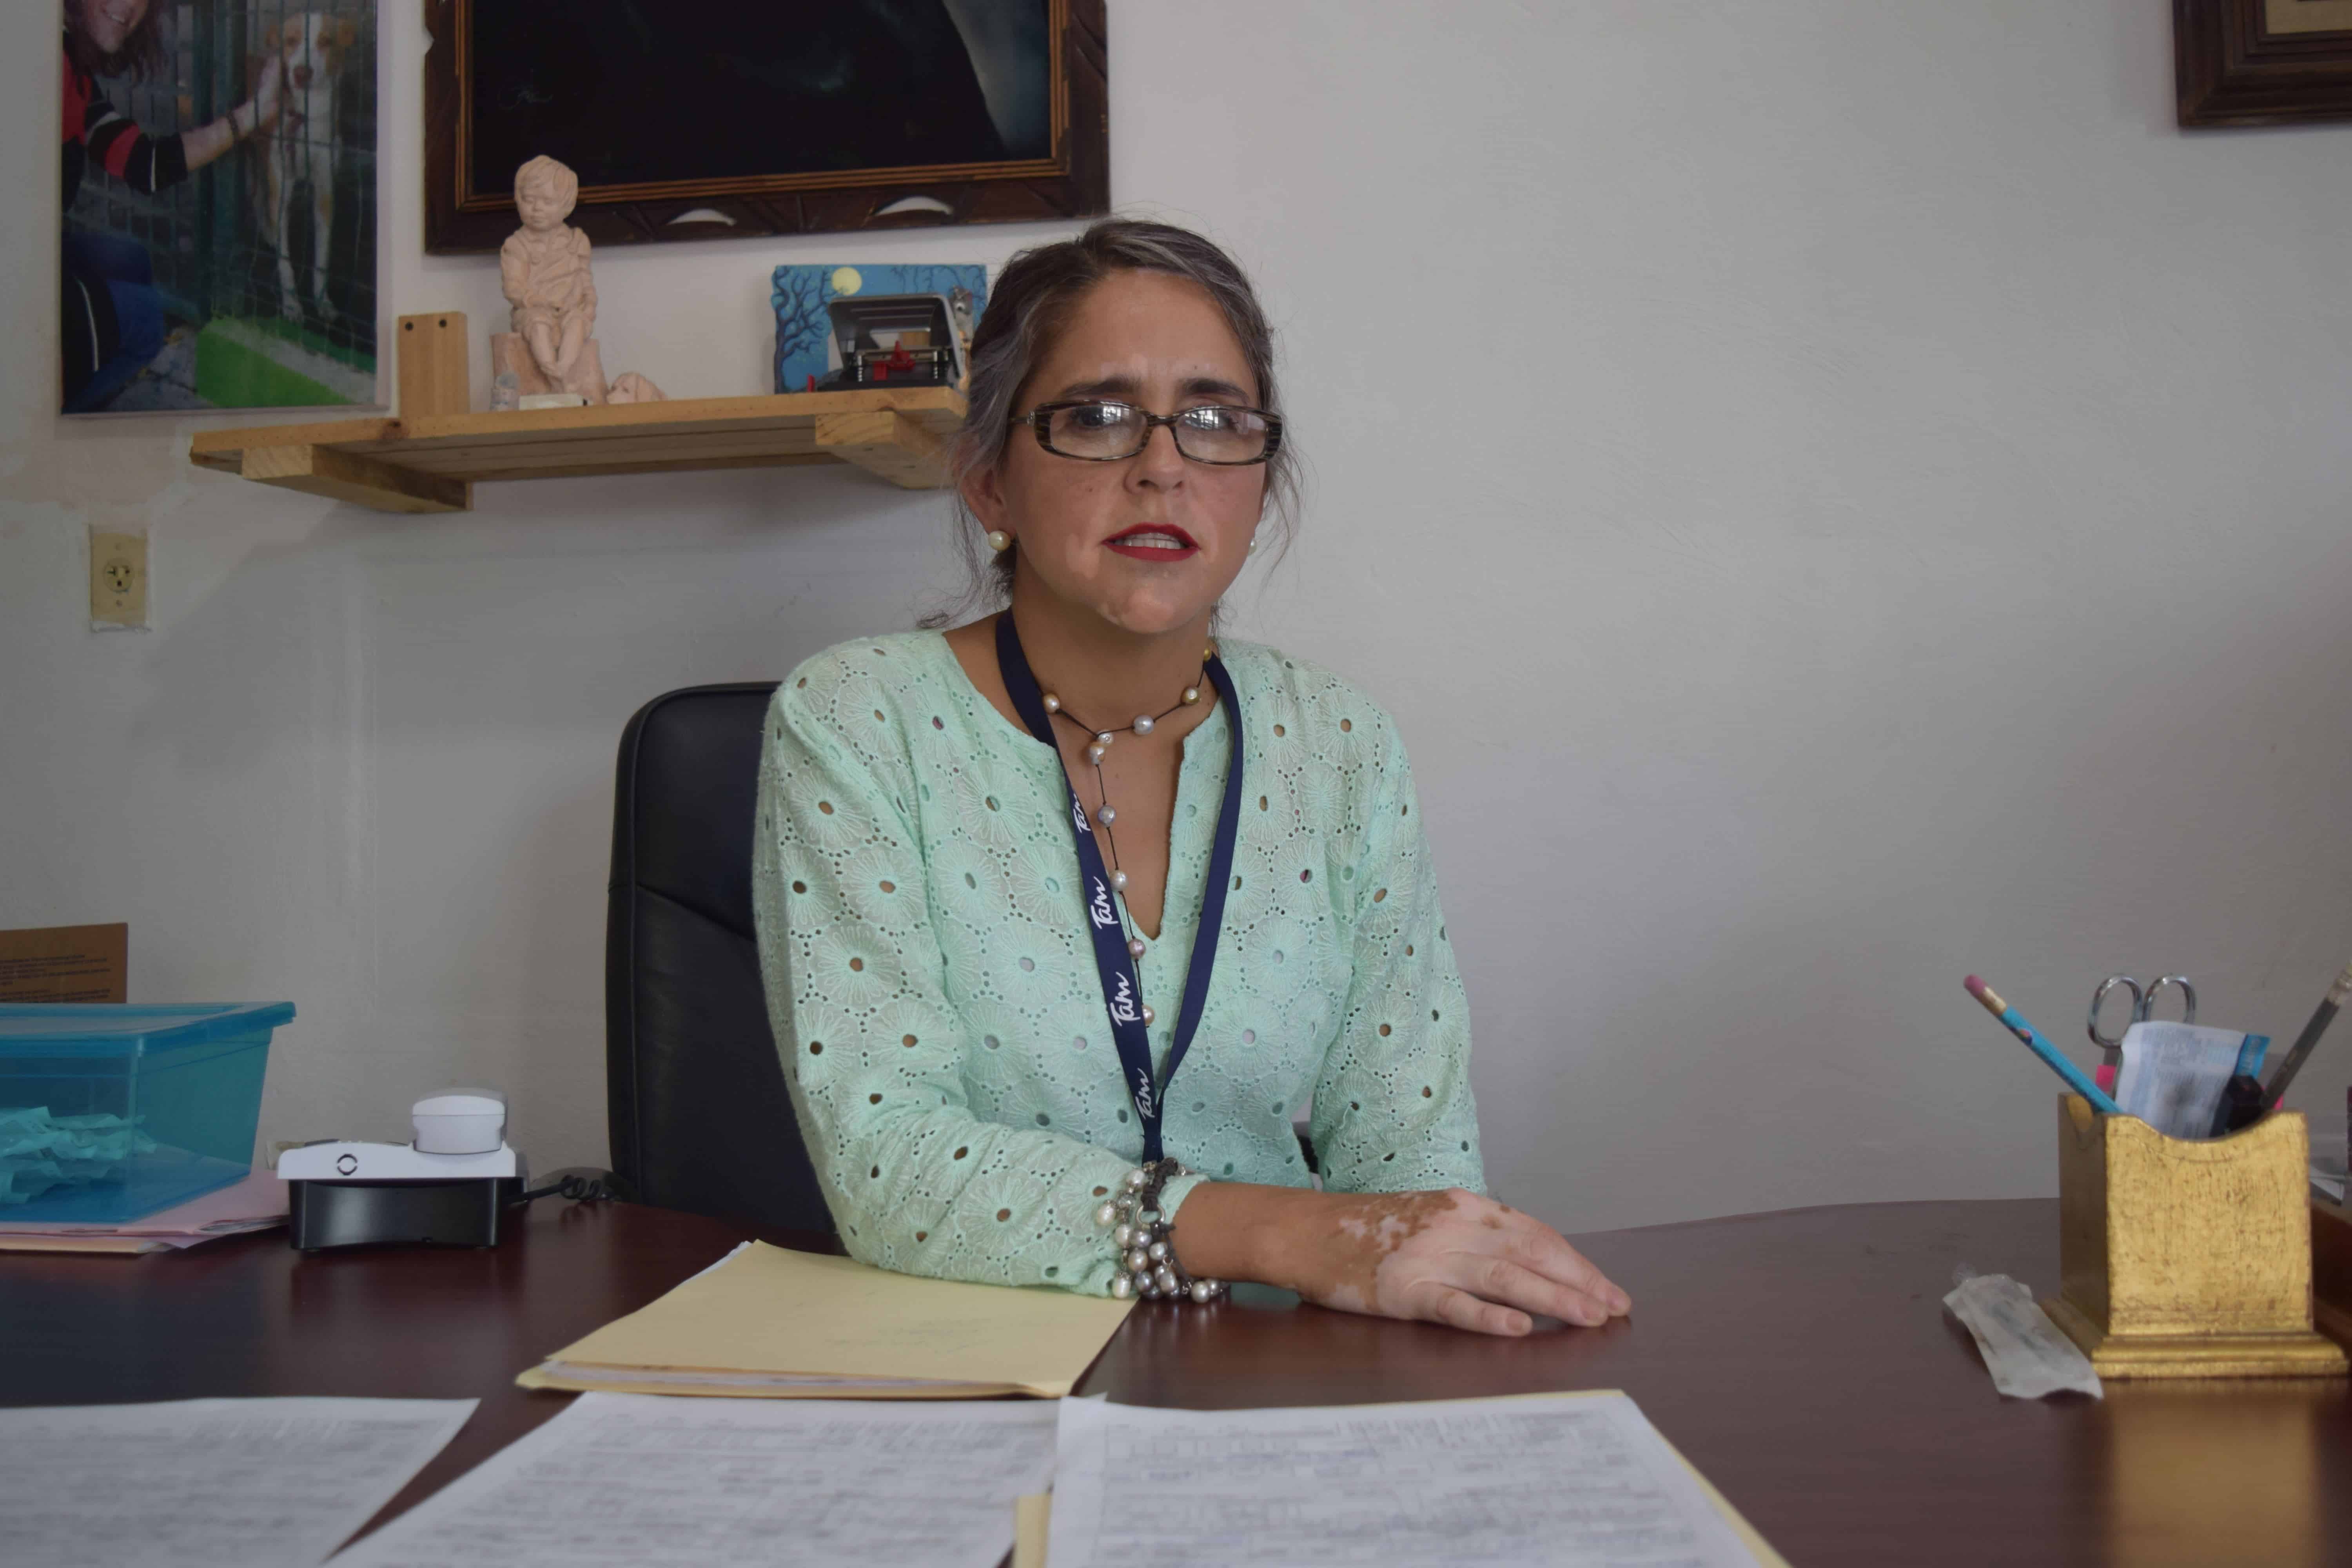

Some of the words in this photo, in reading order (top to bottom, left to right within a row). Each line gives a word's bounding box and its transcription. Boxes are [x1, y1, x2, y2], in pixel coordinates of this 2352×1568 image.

[1073, 793, 1091, 833] Tam
[1091, 876, 1118, 929] Tam
[1110, 972, 1141, 1026] Tam
[1135, 1068, 1155, 1119] Tam
